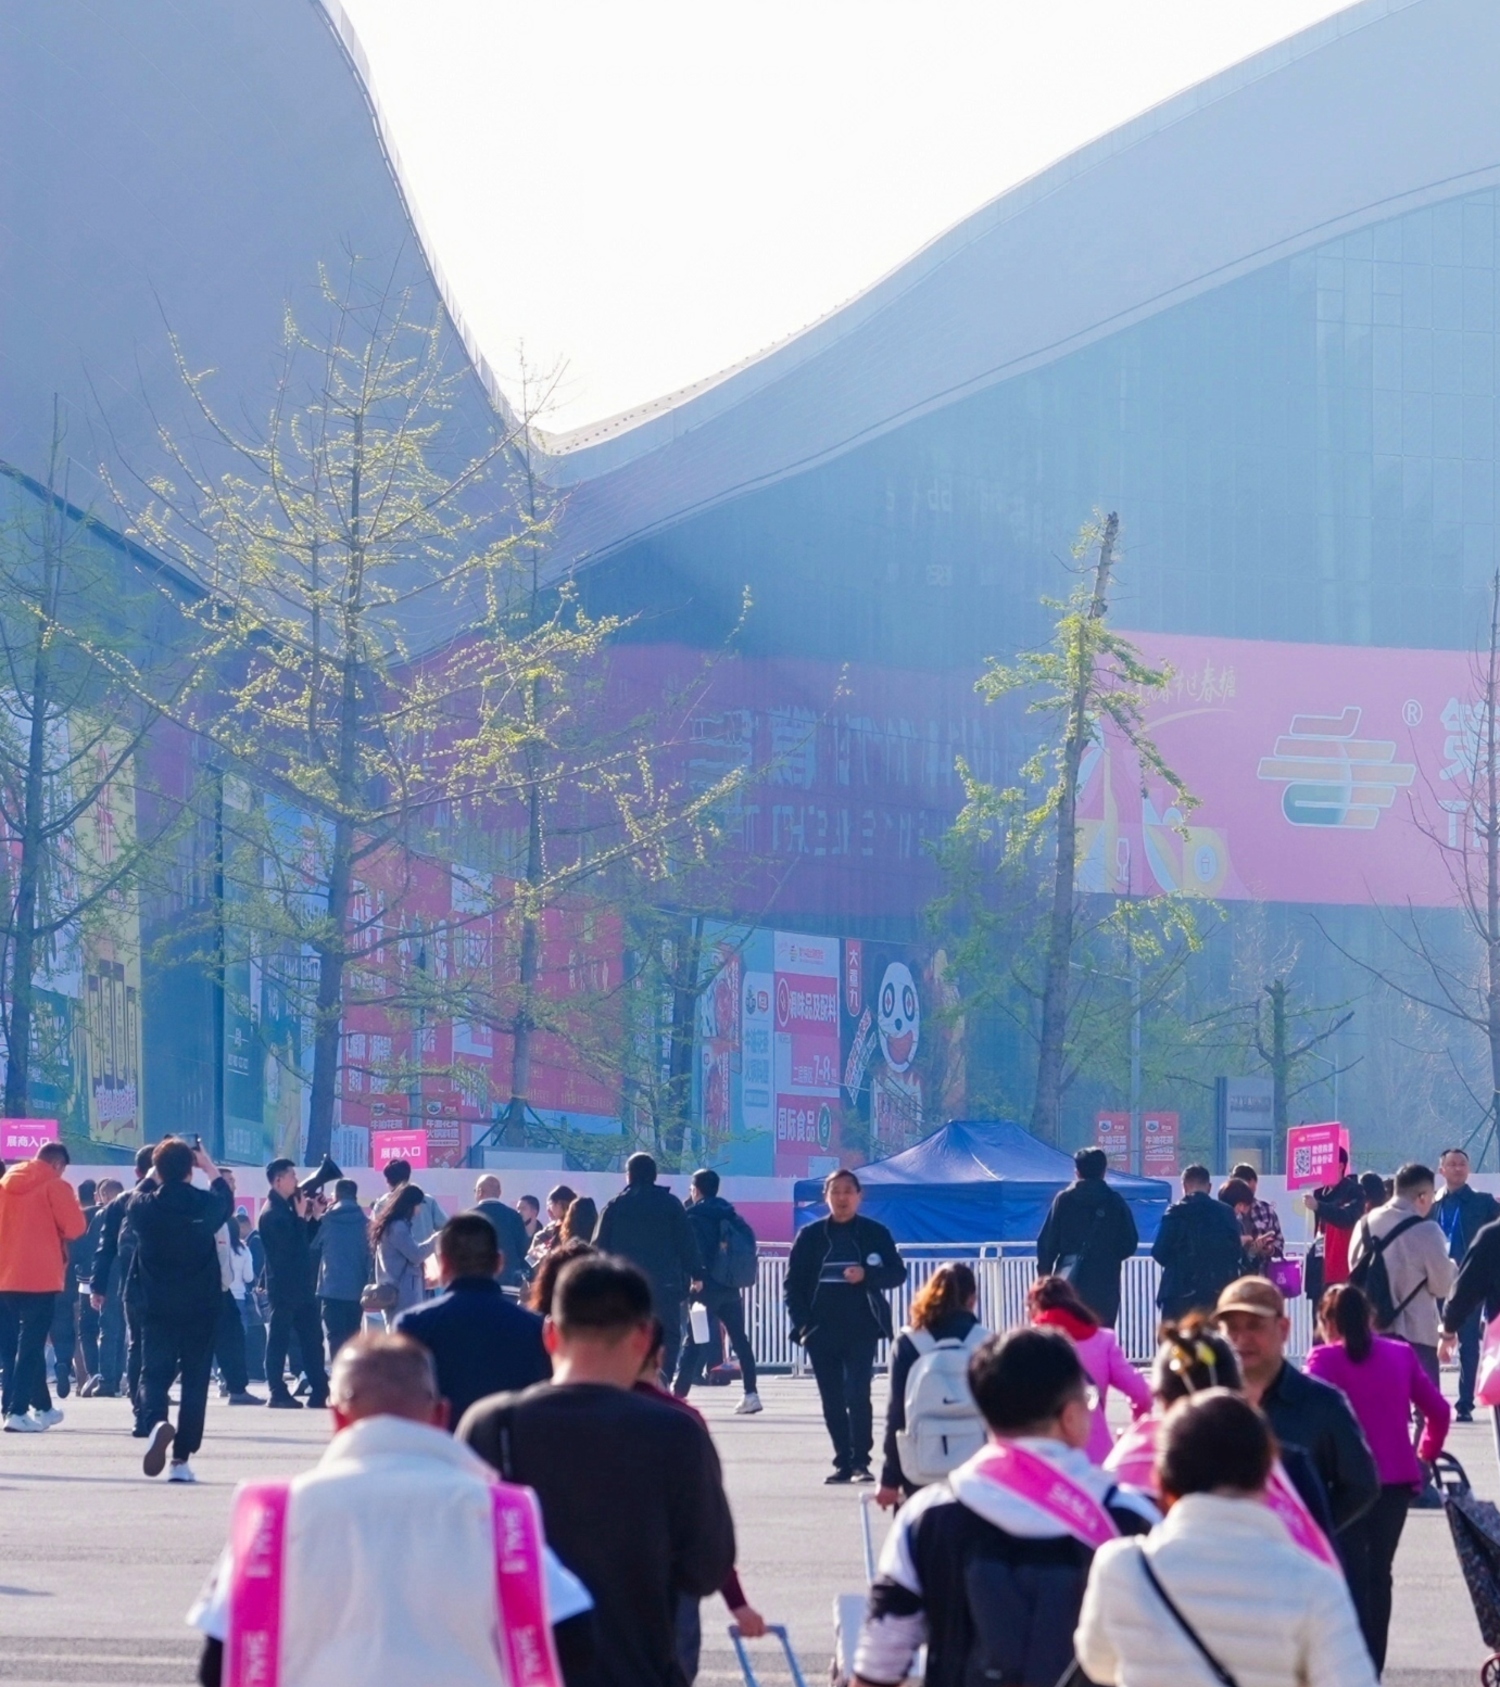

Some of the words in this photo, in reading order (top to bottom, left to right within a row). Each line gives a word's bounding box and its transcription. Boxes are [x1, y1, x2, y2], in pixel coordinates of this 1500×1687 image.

[777, 1106, 816, 1141] 国际食品
[6, 1135, 50, 1148] 展商入口
[380, 1146, 421, 1159] 展商入口
